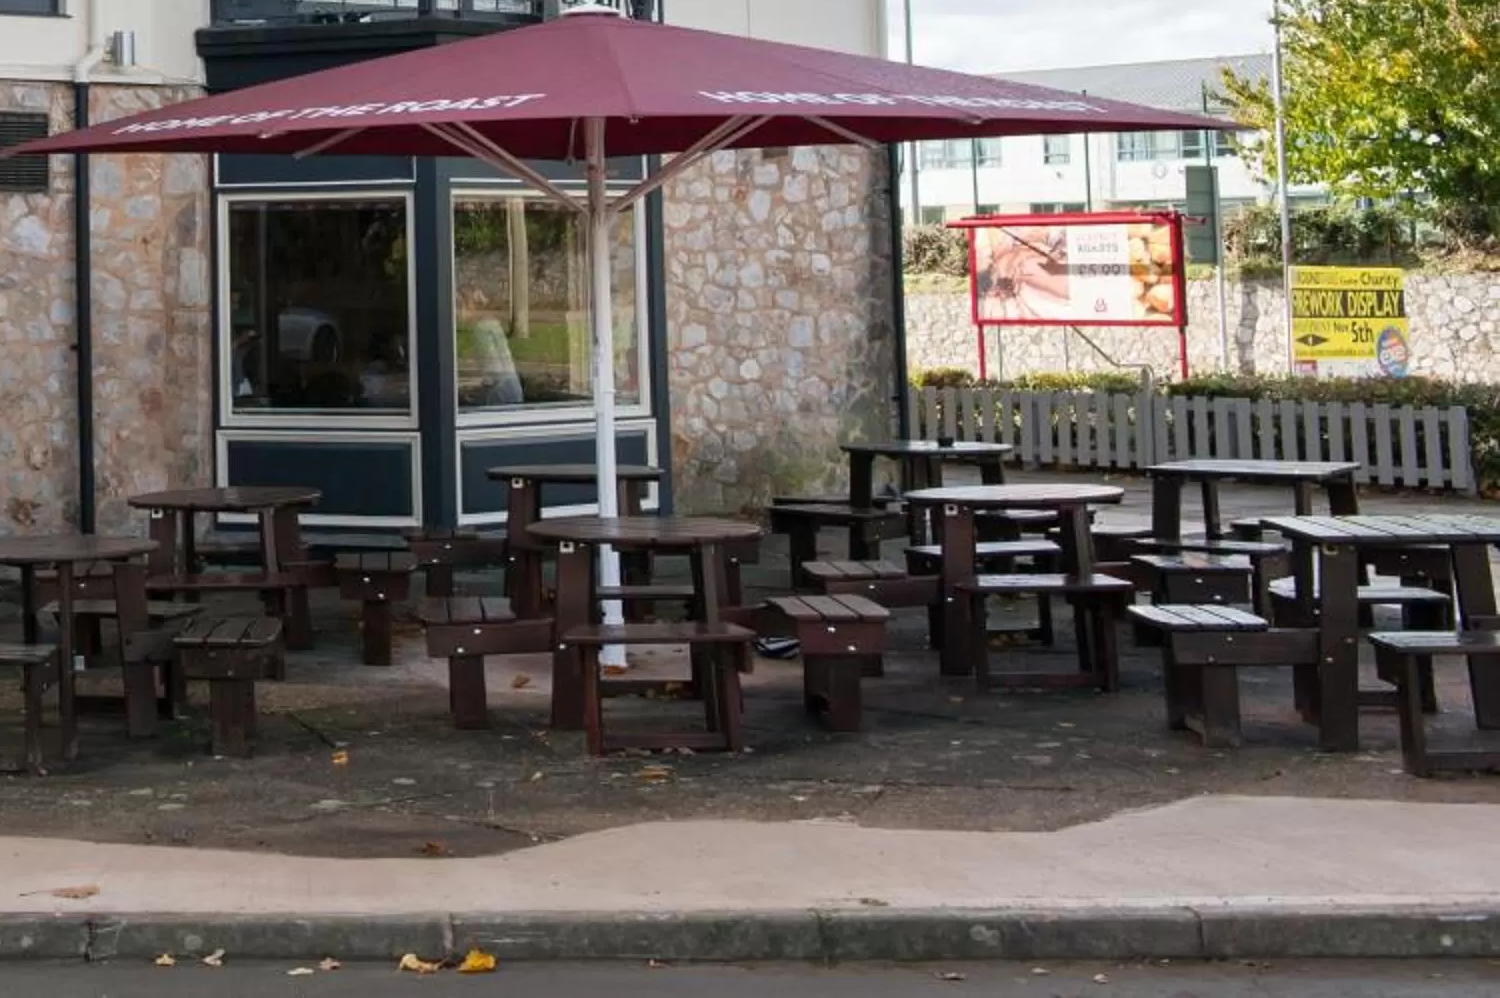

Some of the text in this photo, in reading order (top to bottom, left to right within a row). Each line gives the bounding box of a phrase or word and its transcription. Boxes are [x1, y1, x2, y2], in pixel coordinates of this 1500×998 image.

[111, 93, 547, 135] HOME OF THE ROAST
[1360, 271, 1398, 288] Charity
[1347, 289, 1400, 316] DISPLAY
[1351, 321, 1374, 343] 5th
